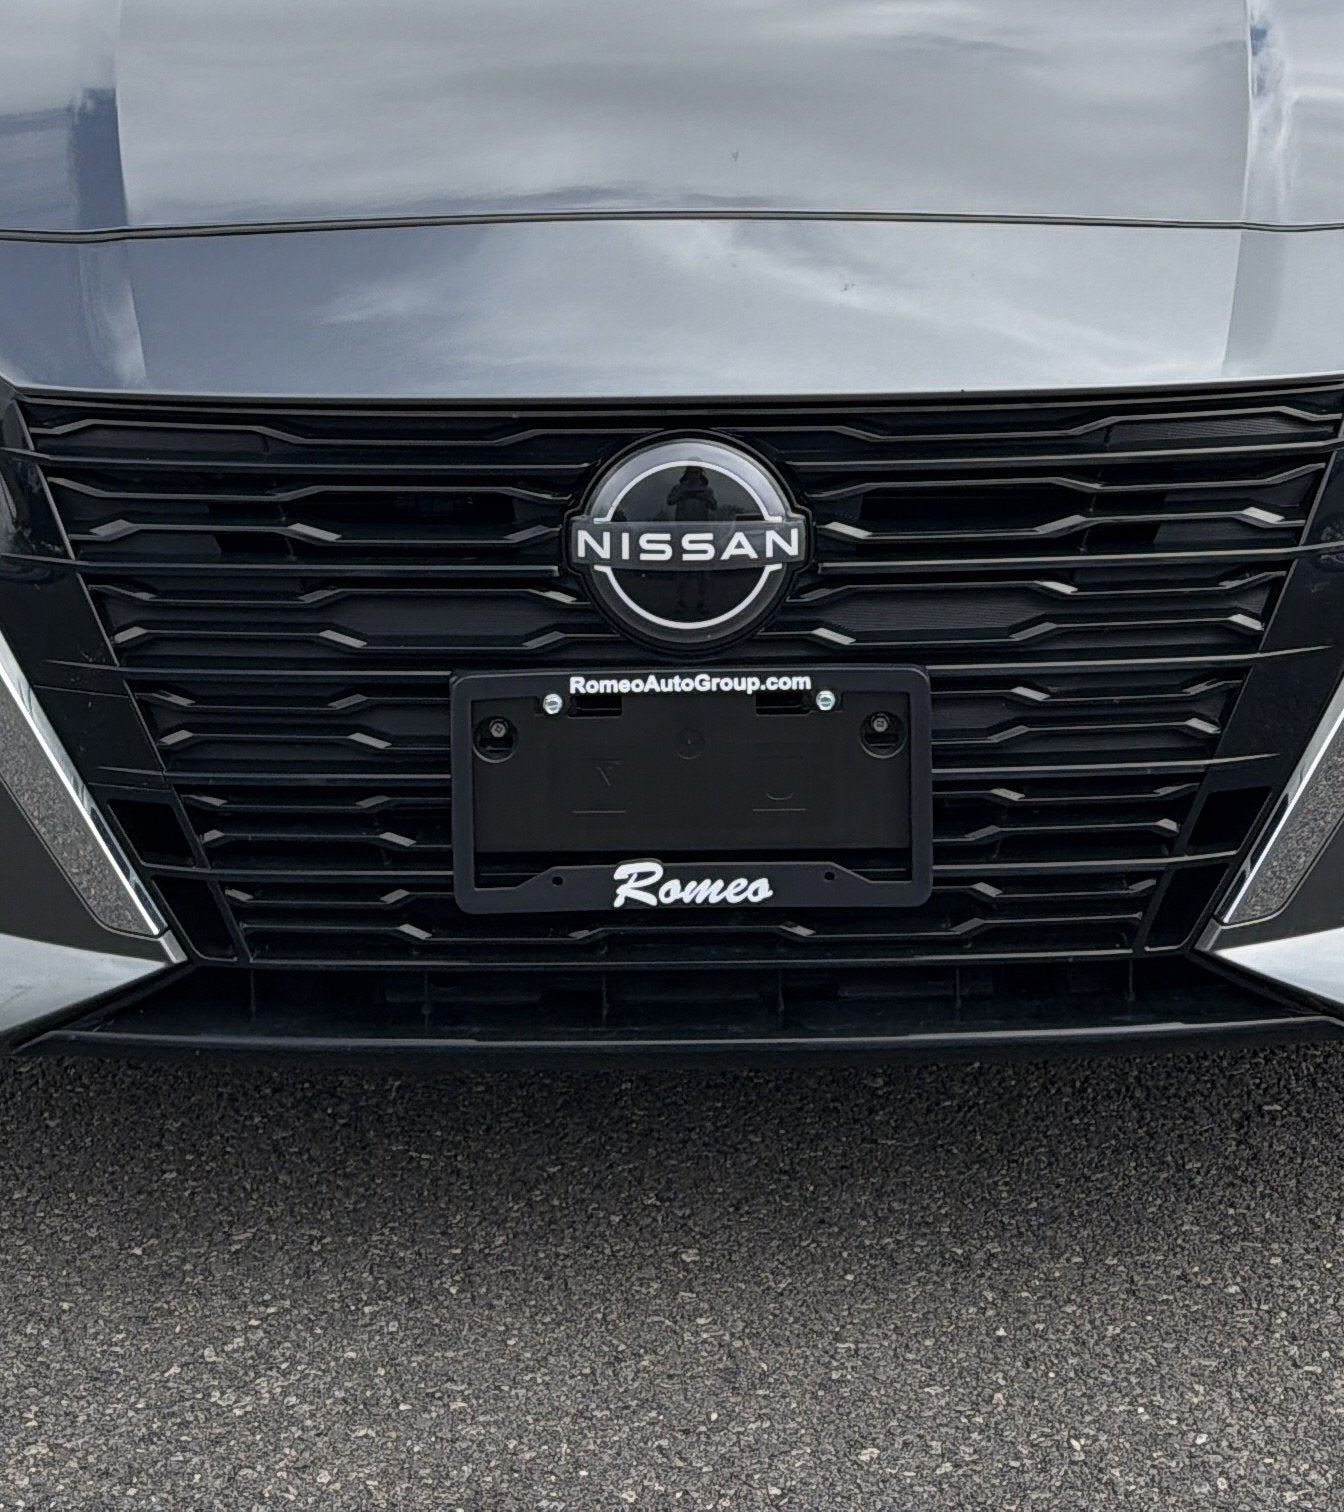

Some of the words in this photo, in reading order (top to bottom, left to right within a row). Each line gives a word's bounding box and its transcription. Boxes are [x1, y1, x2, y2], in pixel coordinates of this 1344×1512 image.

[577, 528, 799, 561] NISSAN
[569, 674, 812, 695] RomeoAutoGroup.com
[612, 861, 774, 908] Romeo
